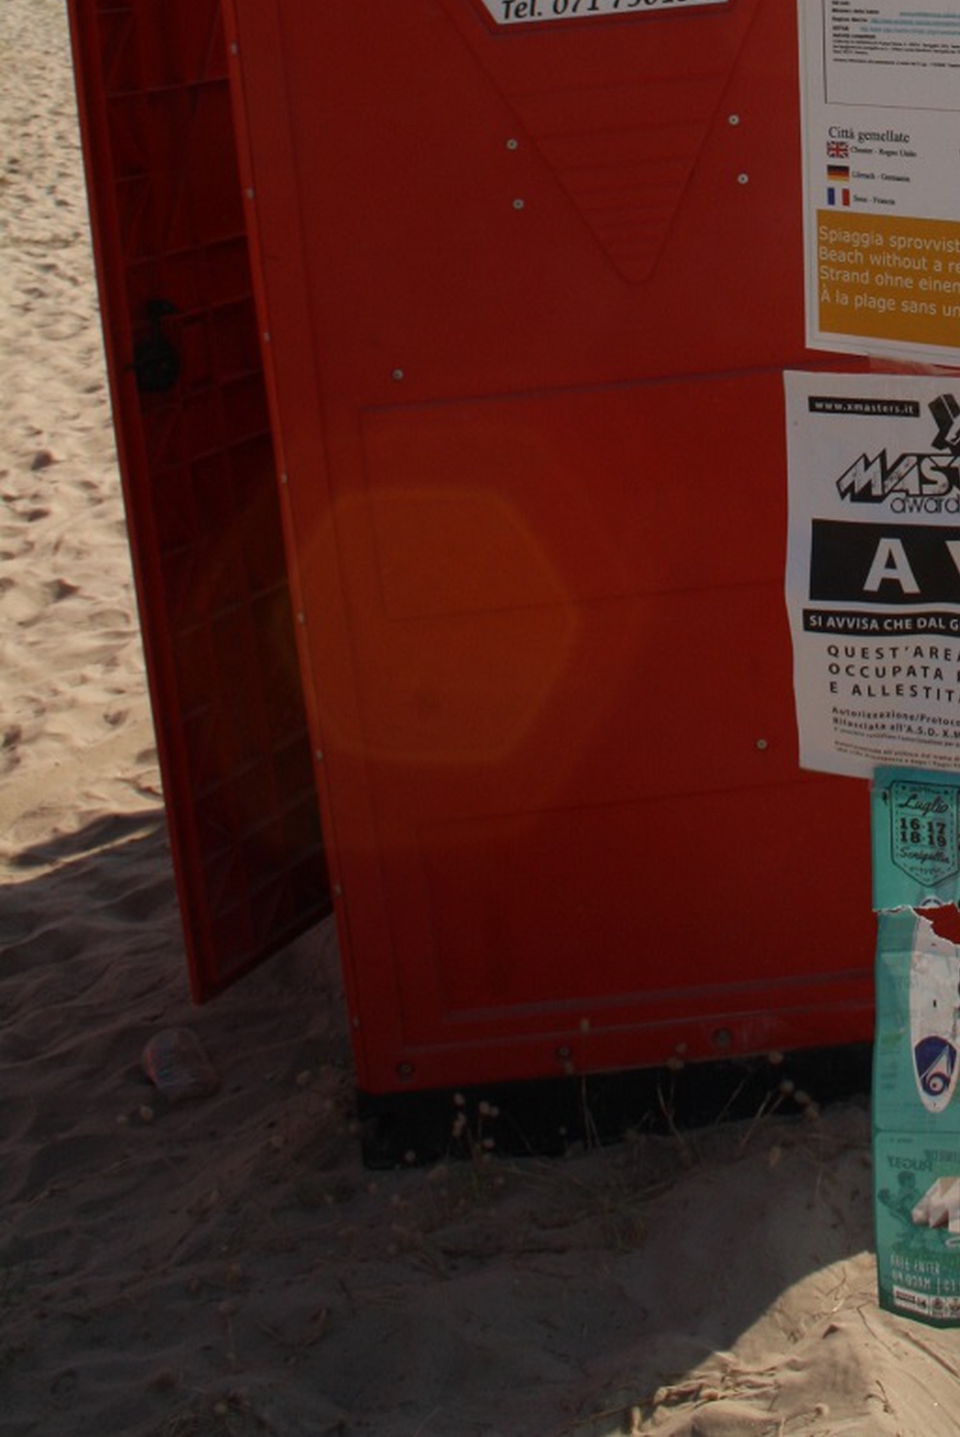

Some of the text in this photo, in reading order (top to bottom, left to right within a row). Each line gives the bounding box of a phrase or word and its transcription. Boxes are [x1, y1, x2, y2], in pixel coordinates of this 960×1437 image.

[827, 125, 910, 144] Città gemellate
[819, 227, 884, 248] Spiaggia
[819, 247, 863, 264] Beach
[869, 253, 927, 271] without
[820, 266, 869, 284] Strand
[874, 272, 913, 289] ohne
[854, 293, 896, 313] plage
[901, 299, 937, 316] sans
[815, 399, 916, 415] www.xmasters.it
[891, 494, 960, 514] award
[809, 614, 822, 626] SI
[826, 615, 879, 630] AVVISA
[828, 662, 943, 681] OCCUPATA
[899, 793, 950, 816] Luglio
